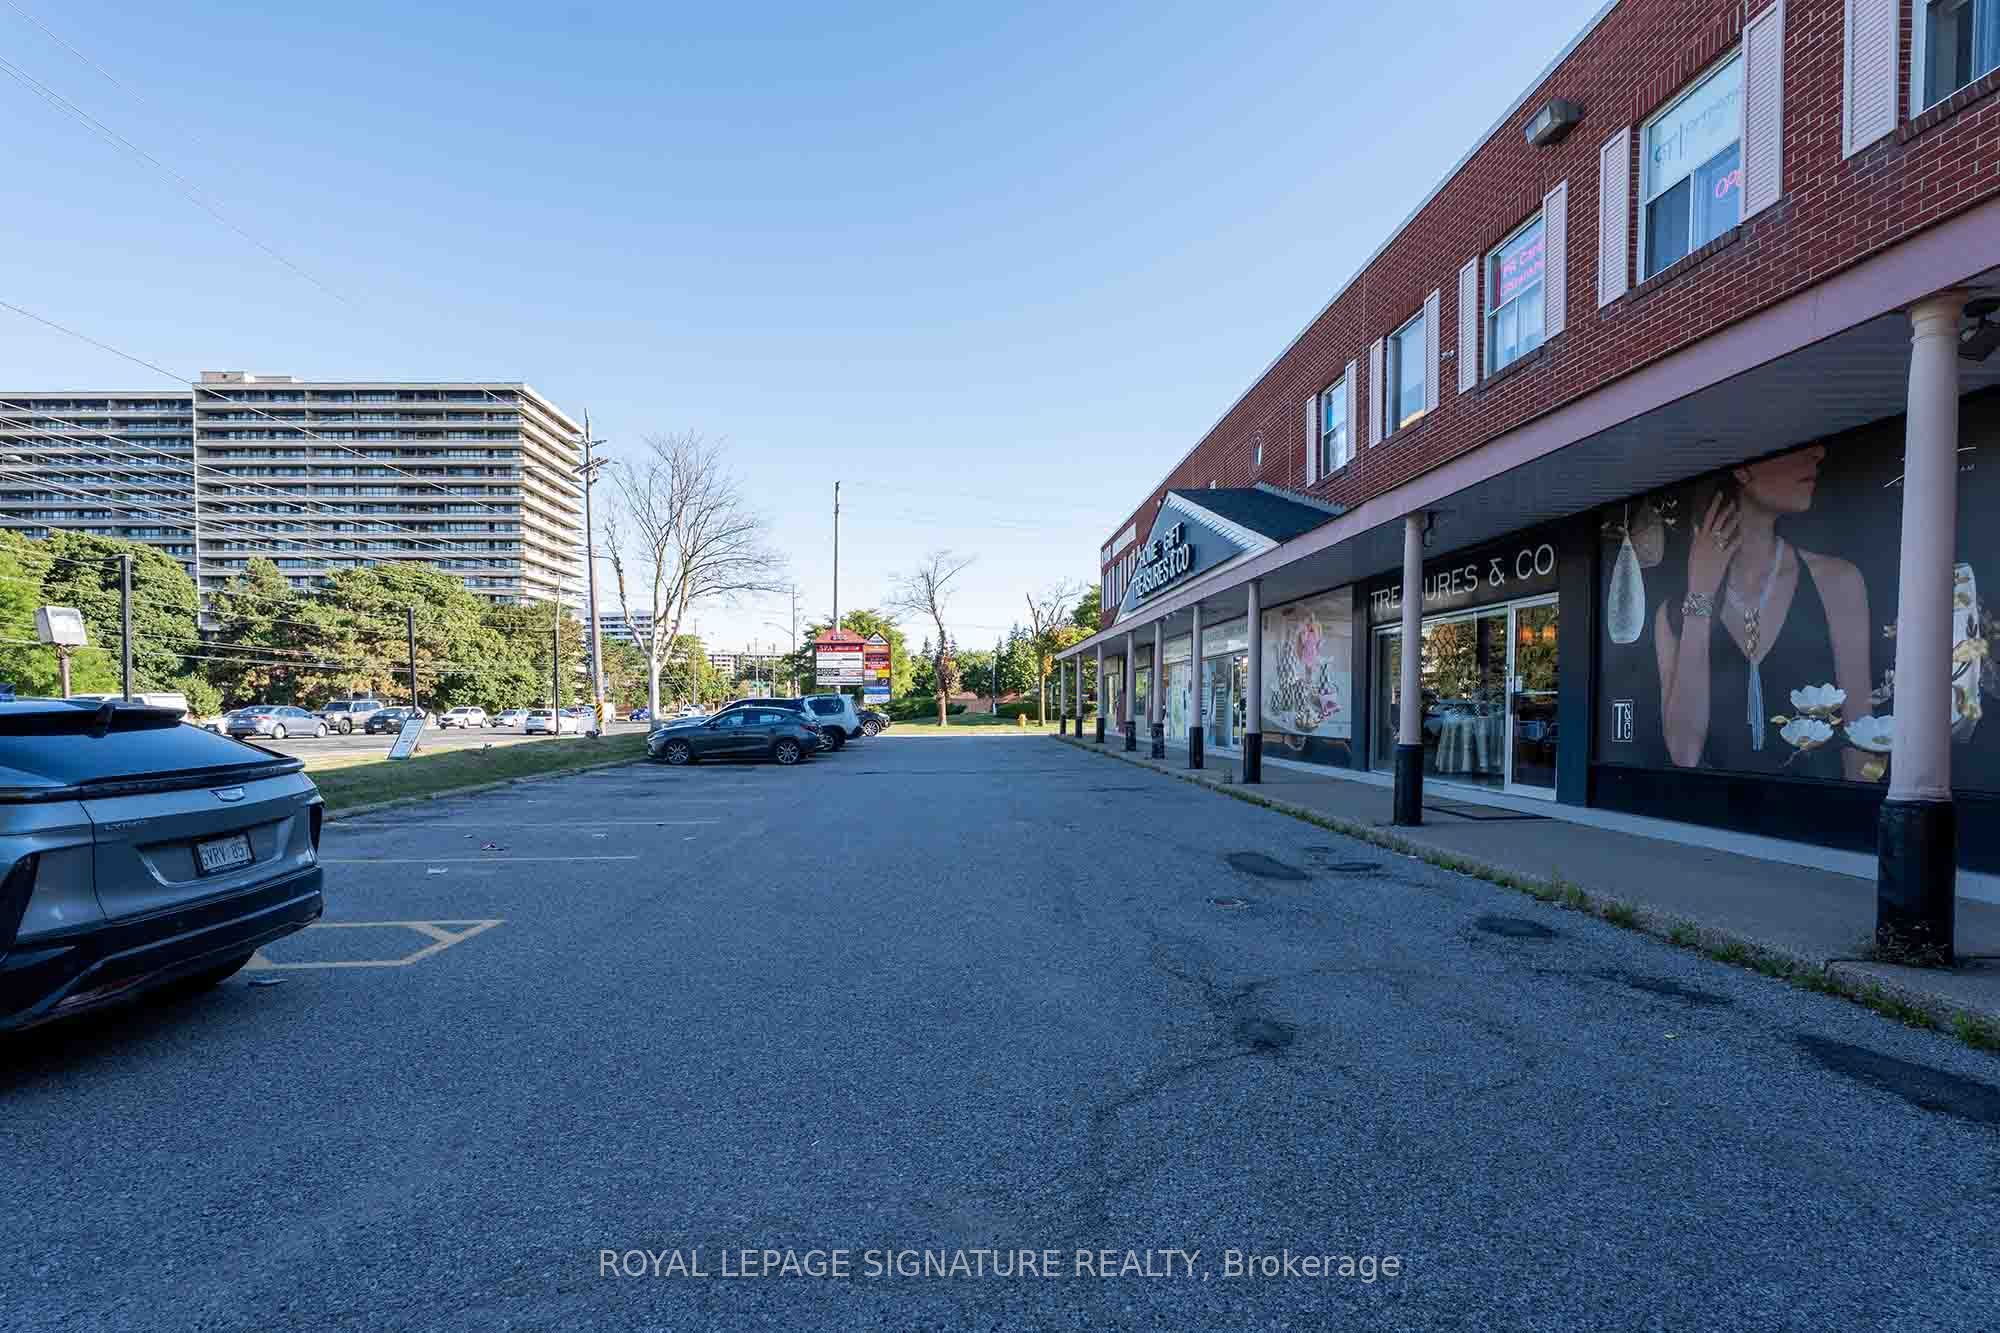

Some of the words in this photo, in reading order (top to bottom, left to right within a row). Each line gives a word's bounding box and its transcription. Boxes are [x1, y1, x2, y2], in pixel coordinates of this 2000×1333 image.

[1176, 543, 1189, 574] CO
[1370, 564, 1479, 612] TREURES
[1488, 557, 1505, 587] &
[1515, 543, 1555, 580] CO
